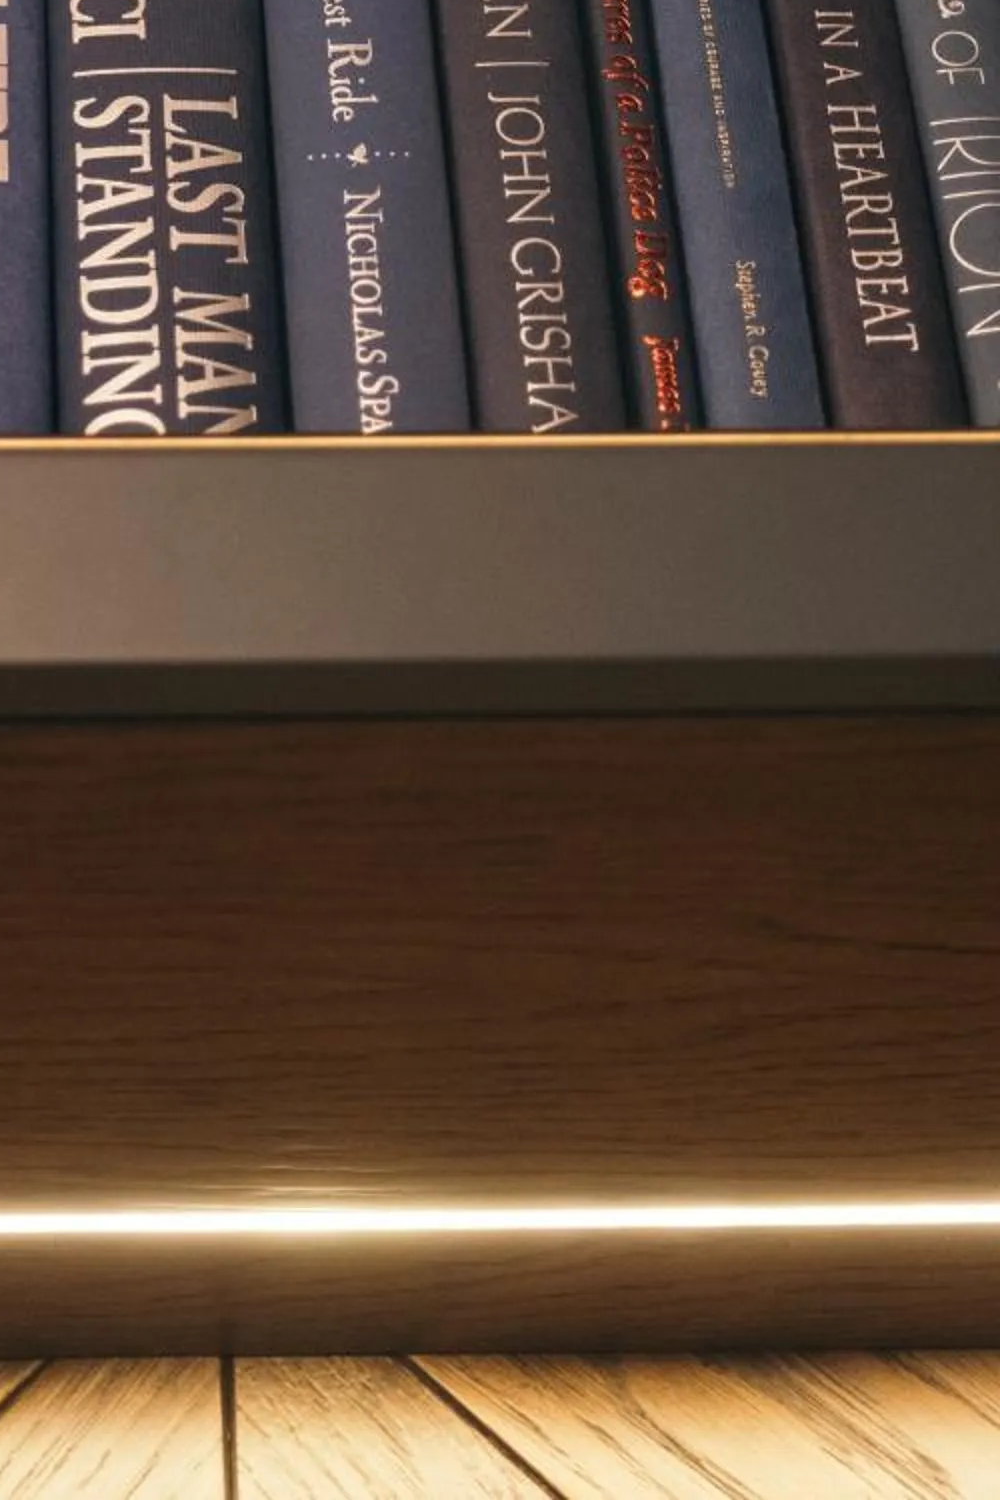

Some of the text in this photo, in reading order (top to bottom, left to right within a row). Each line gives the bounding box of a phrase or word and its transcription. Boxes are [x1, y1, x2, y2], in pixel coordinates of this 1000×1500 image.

[326, 38, 378, 124] Ride
[601, 54, 649, 92] of
[931, 30, 986, 85] OF
[163, 94, 249, 264] LAST
[488, 90, 555, 225] JOHN
[620, 121, 663, 220] Police
[815, 9, 919, 352] IN A HEARTBEAT
[627, 230, 671, 300] Dog
[735, 260, 761, 319] Stephen
[749, 345, 769, 397] Covey
